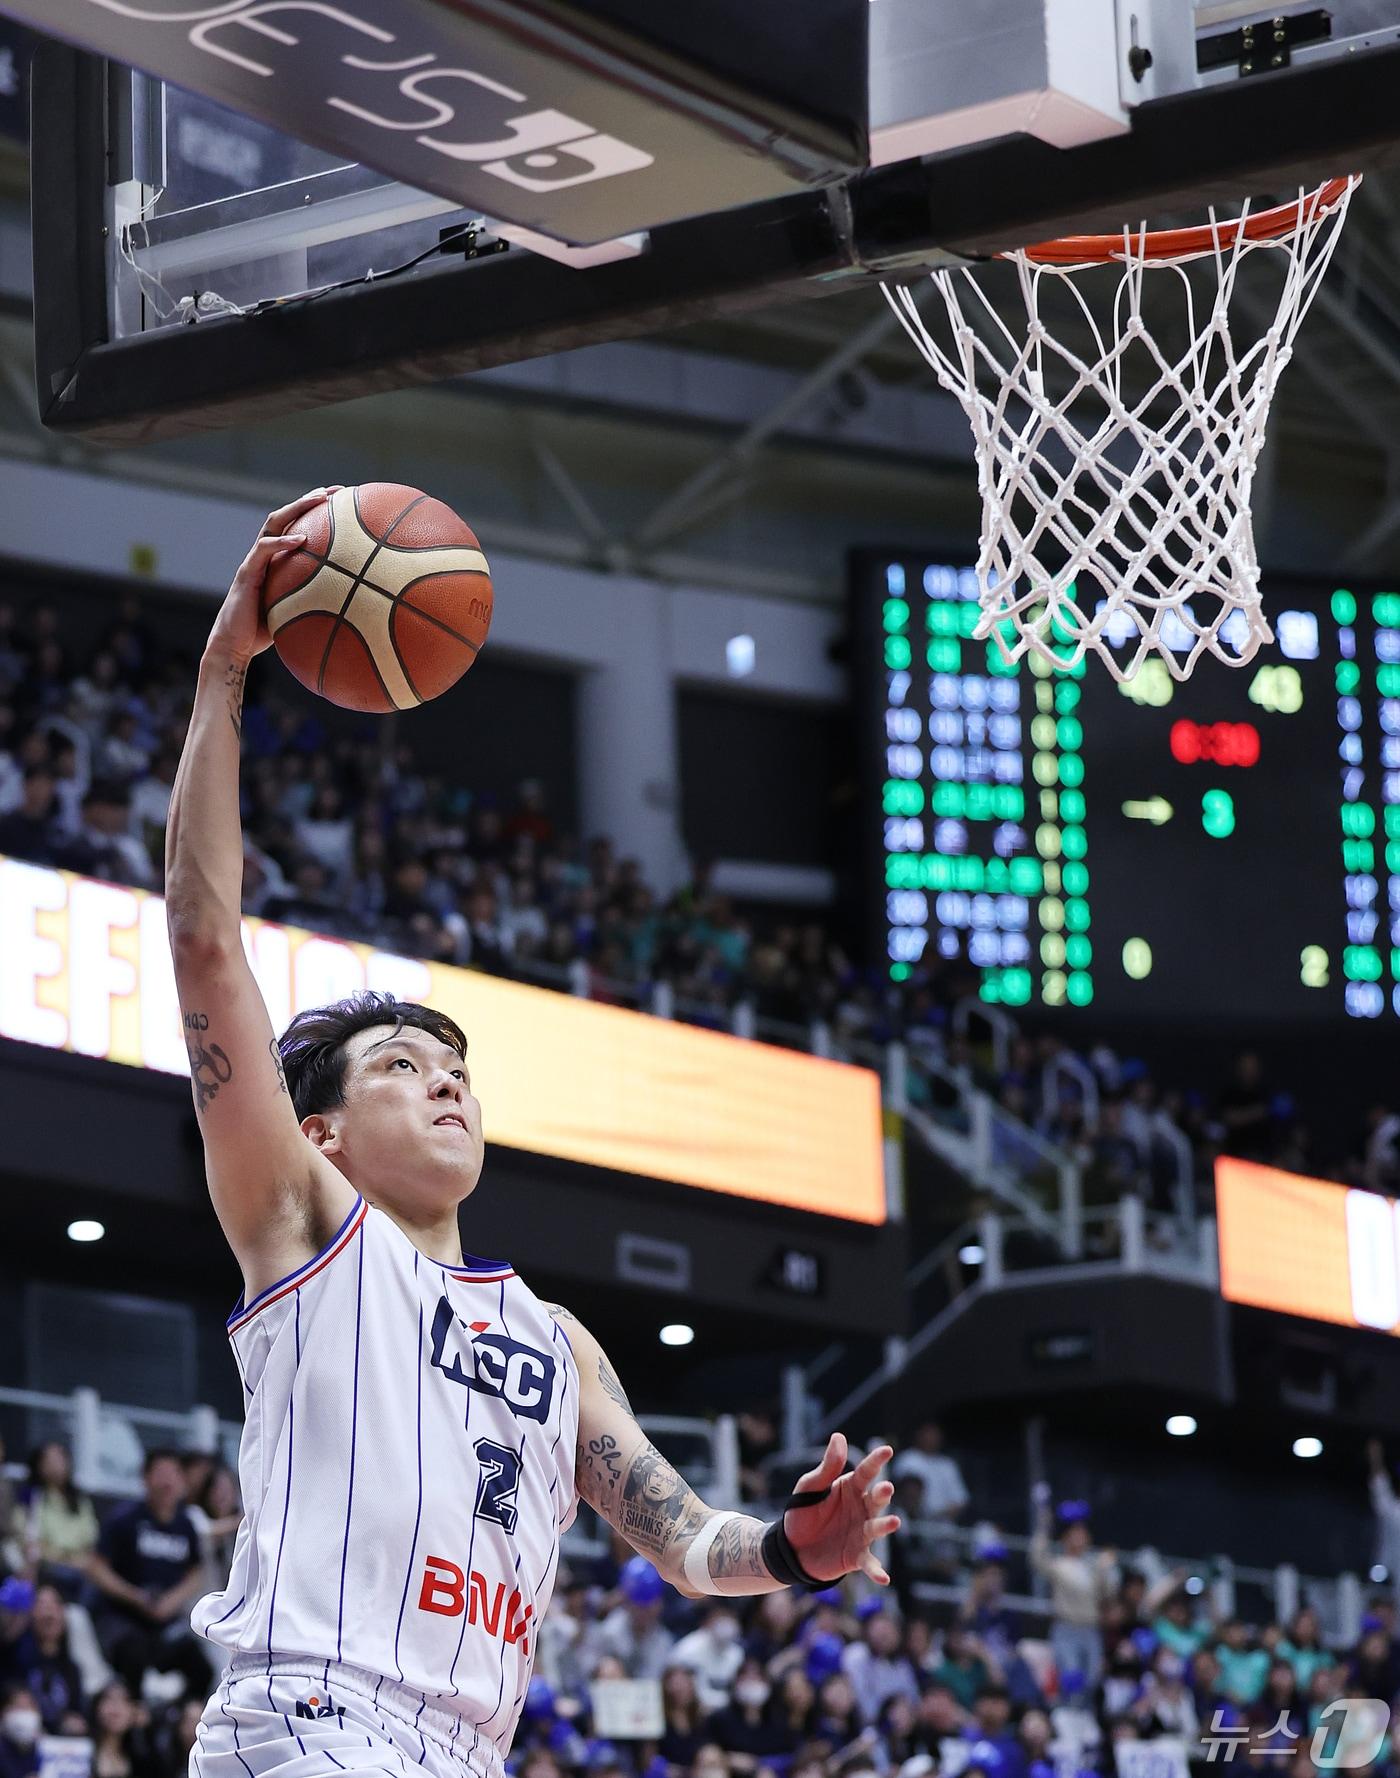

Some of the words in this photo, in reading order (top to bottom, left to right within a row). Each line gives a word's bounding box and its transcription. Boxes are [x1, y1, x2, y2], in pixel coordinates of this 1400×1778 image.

[436, 1308, 549, 1410] KCC
[473, 1436, 523, 1536] 2
[626, 1510, 663, 1537] SHANKS
